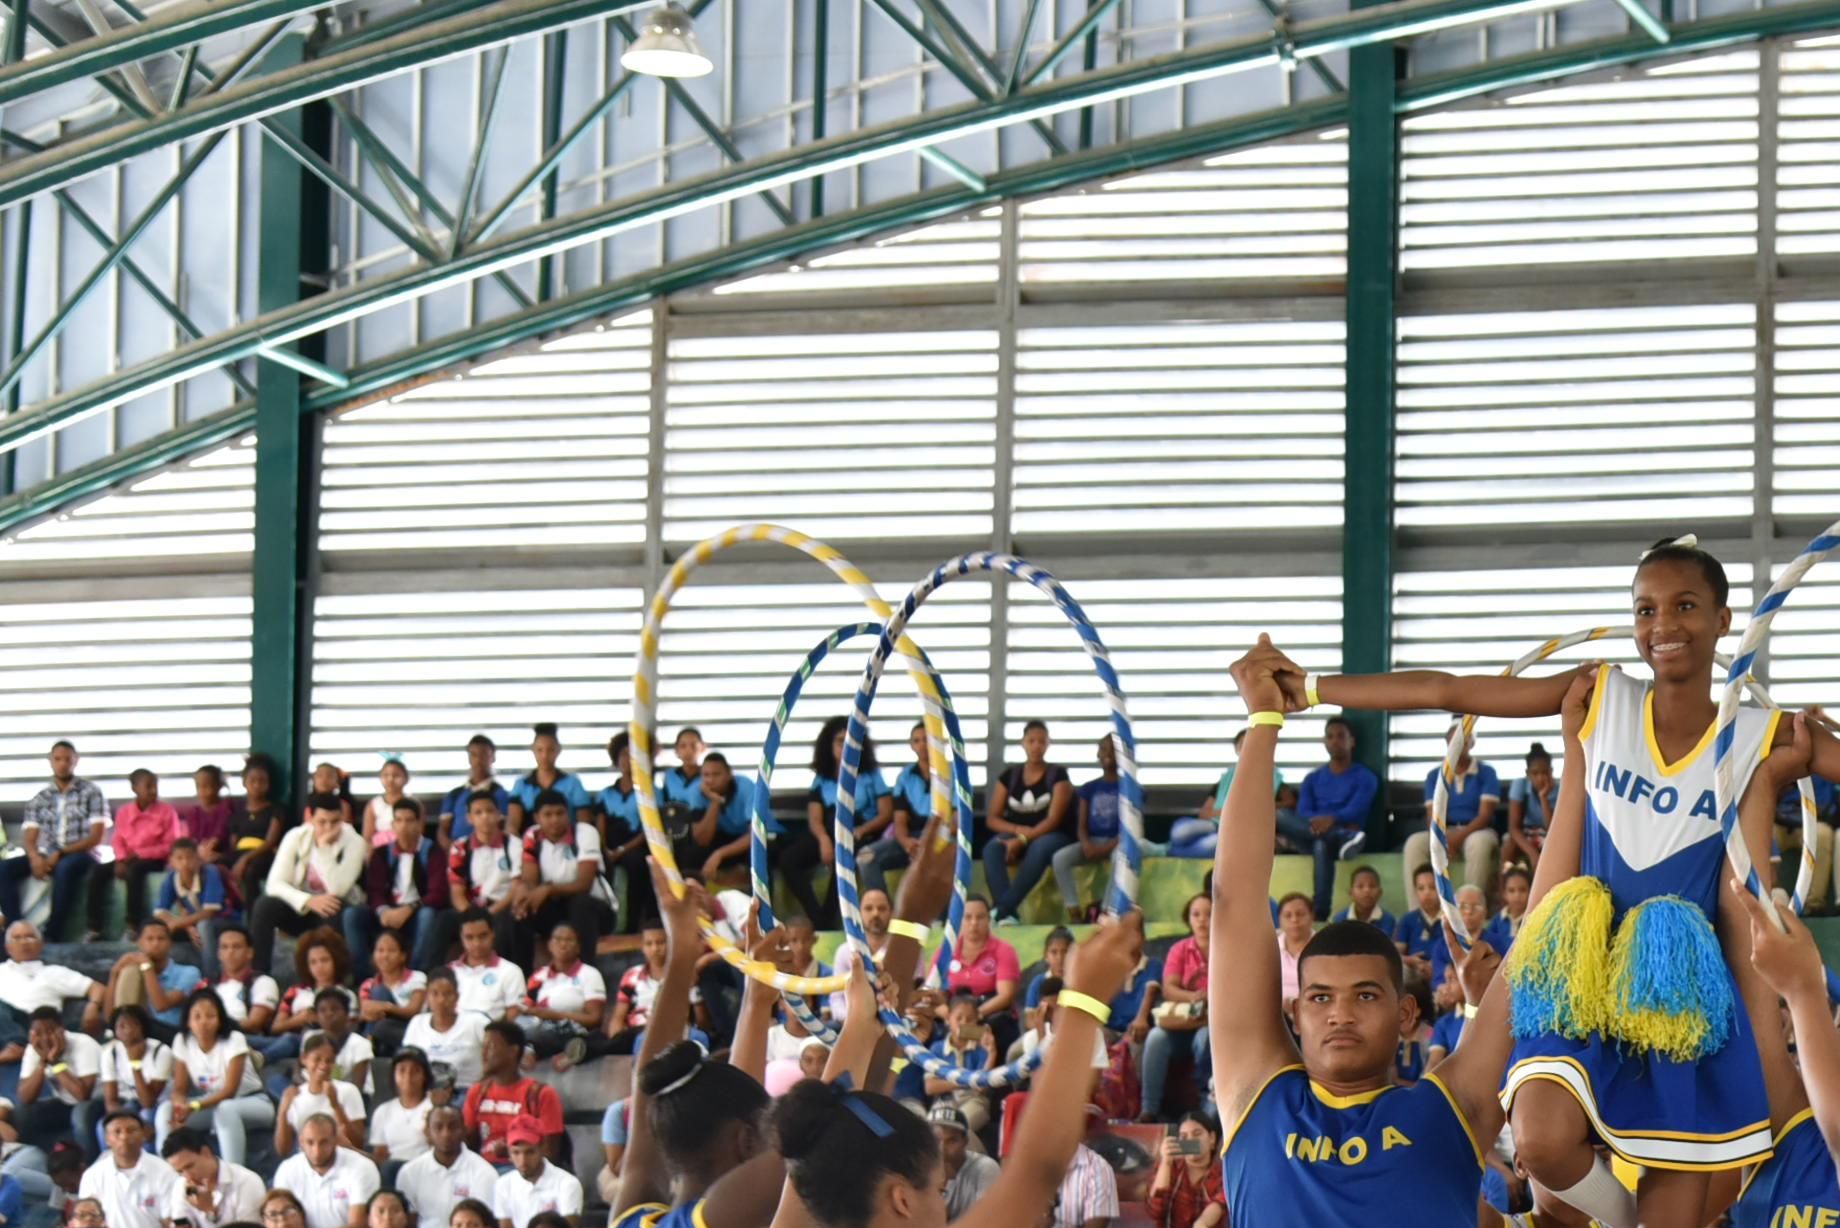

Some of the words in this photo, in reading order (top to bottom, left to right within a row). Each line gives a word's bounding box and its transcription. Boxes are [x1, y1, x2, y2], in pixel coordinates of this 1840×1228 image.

[1595, 760, 1679, 814] INFO
[1689, 789, 1717, 820] A
[1382, 1125, 1413, 1151] A
